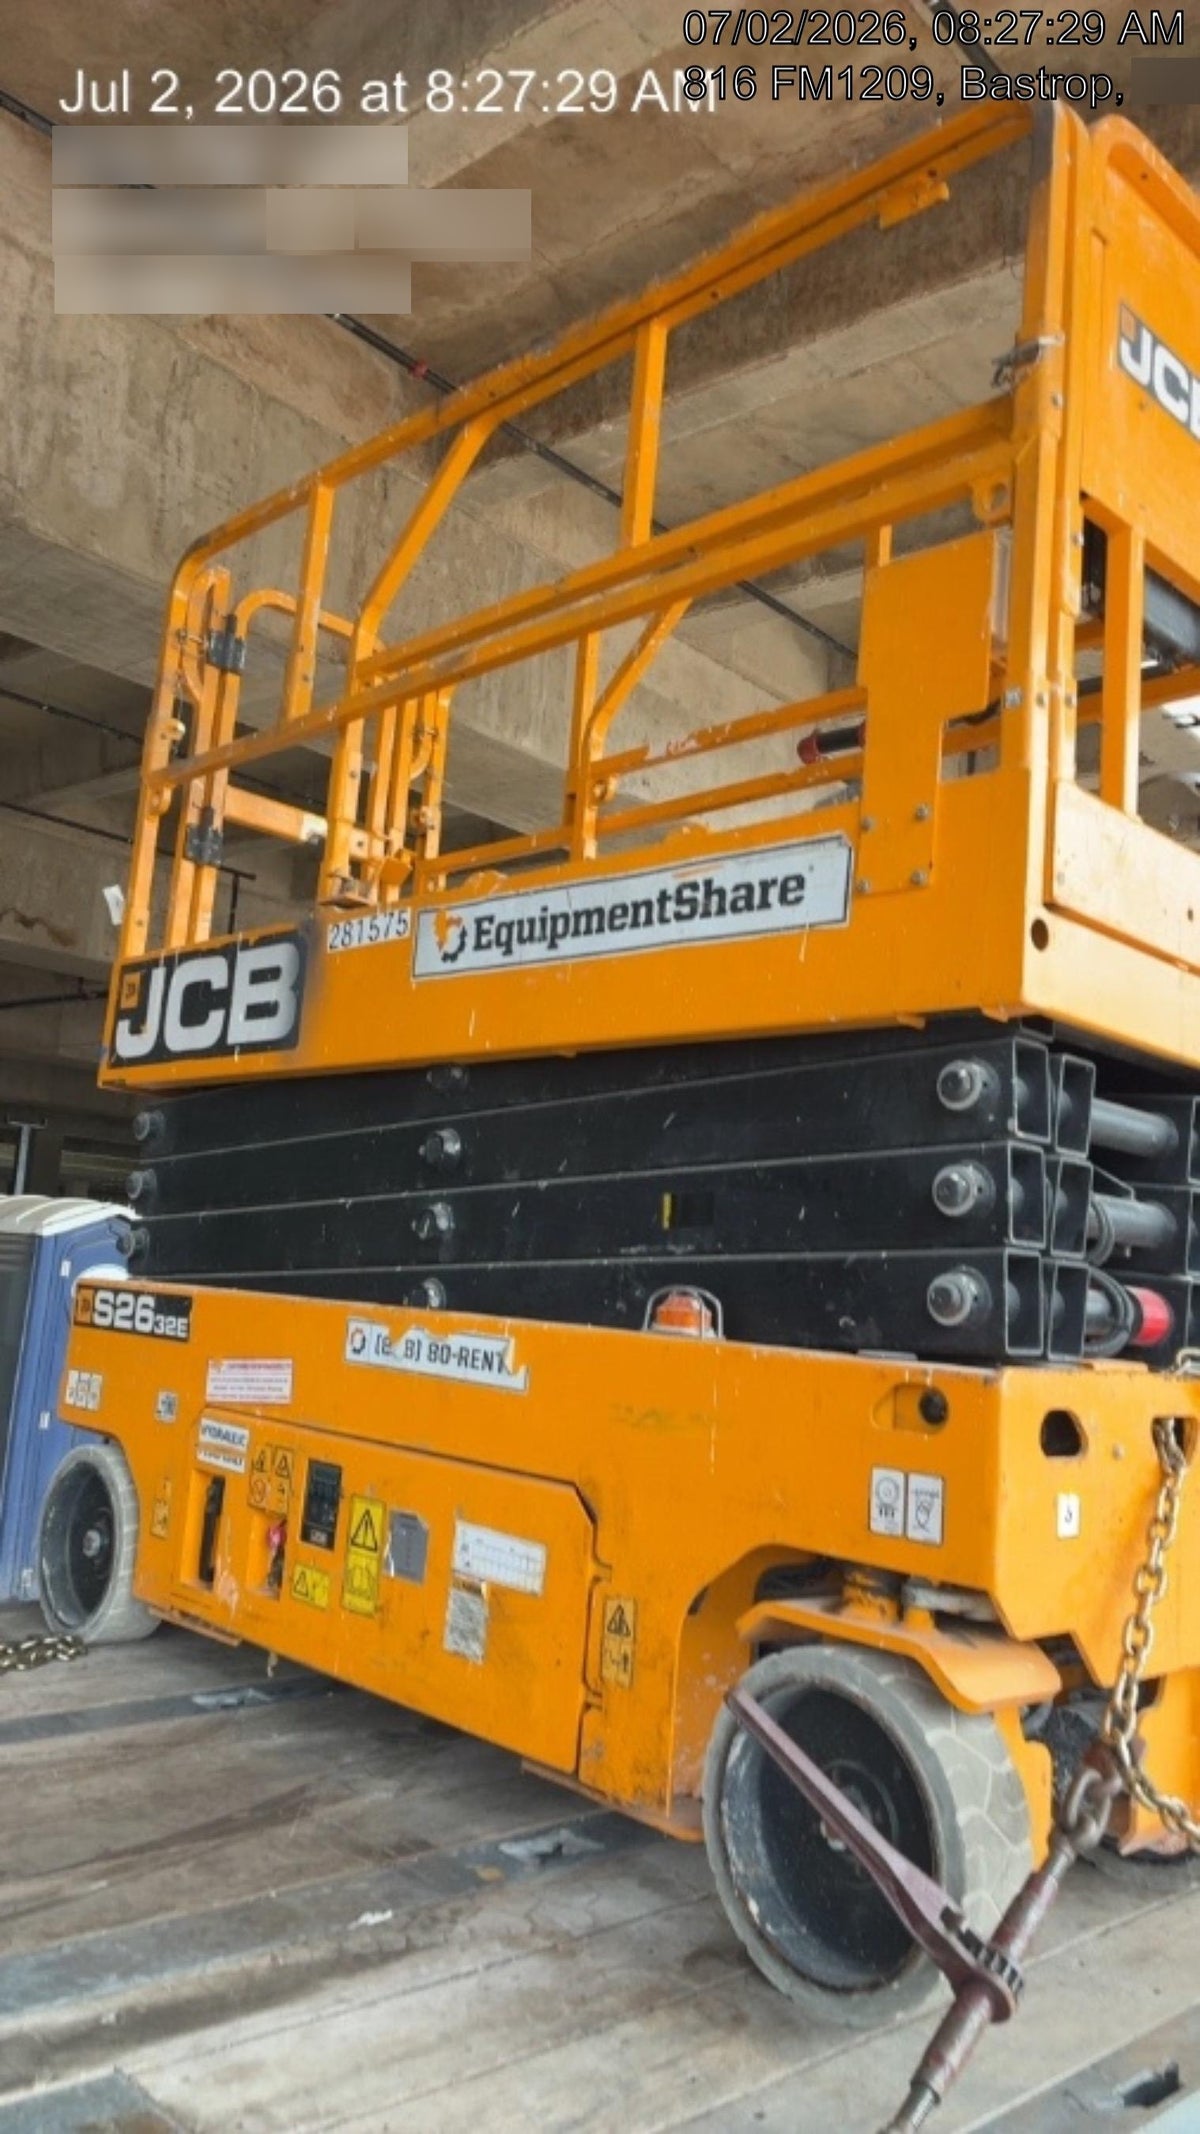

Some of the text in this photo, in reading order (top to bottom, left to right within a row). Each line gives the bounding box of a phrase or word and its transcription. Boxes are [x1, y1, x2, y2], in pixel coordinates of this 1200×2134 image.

[1120, 327, 1200, 442] JC
[329, 909, 409, 950] 281575
[473, 871, 806, 956] EquipmentShare
[115, 942, 302, 1059] JCB
